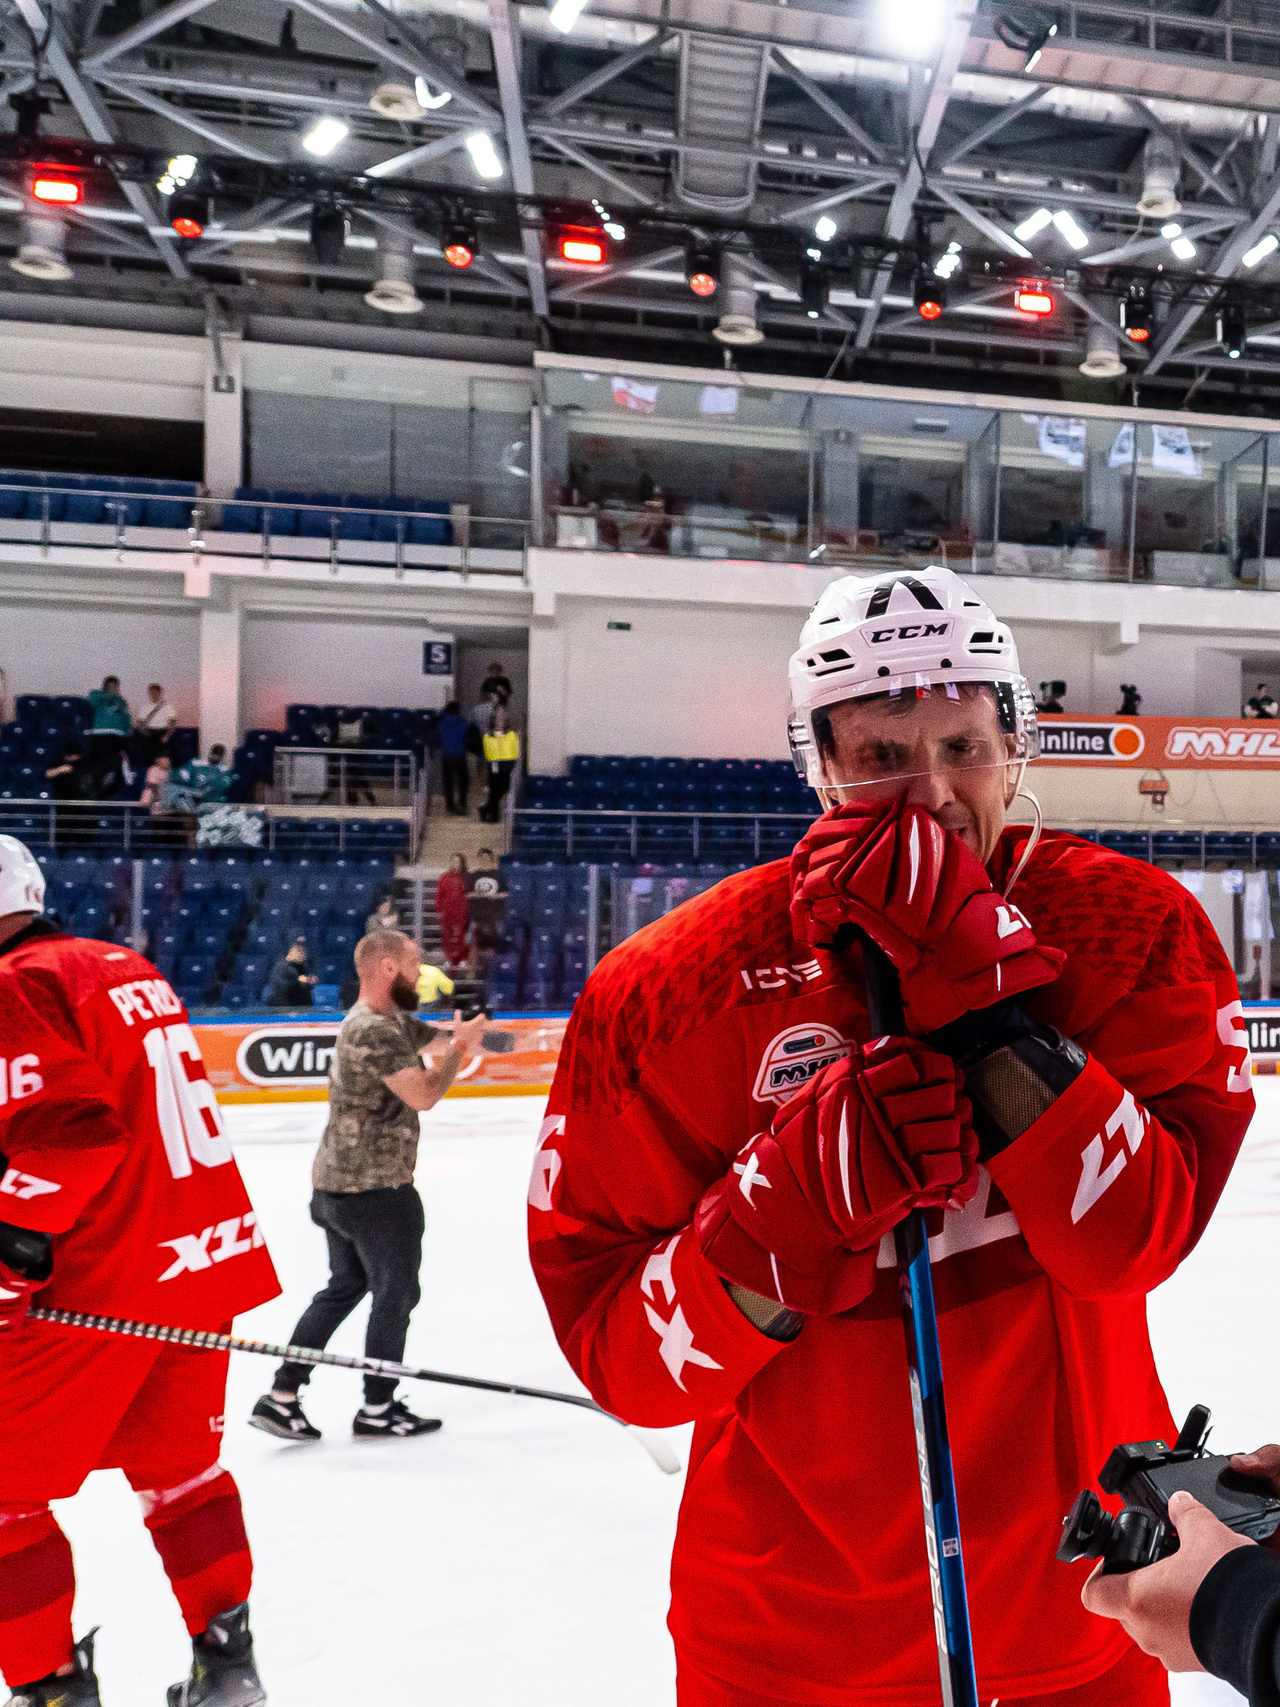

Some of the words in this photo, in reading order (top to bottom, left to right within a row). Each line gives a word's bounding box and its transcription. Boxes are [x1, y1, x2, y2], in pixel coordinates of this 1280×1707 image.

[871, 622, 949, 644] CCM
[1039, 730, 1105, 752] inline
[259, 1041, 338, 1073] Win
[142, 1022, 235, 1180] 16
